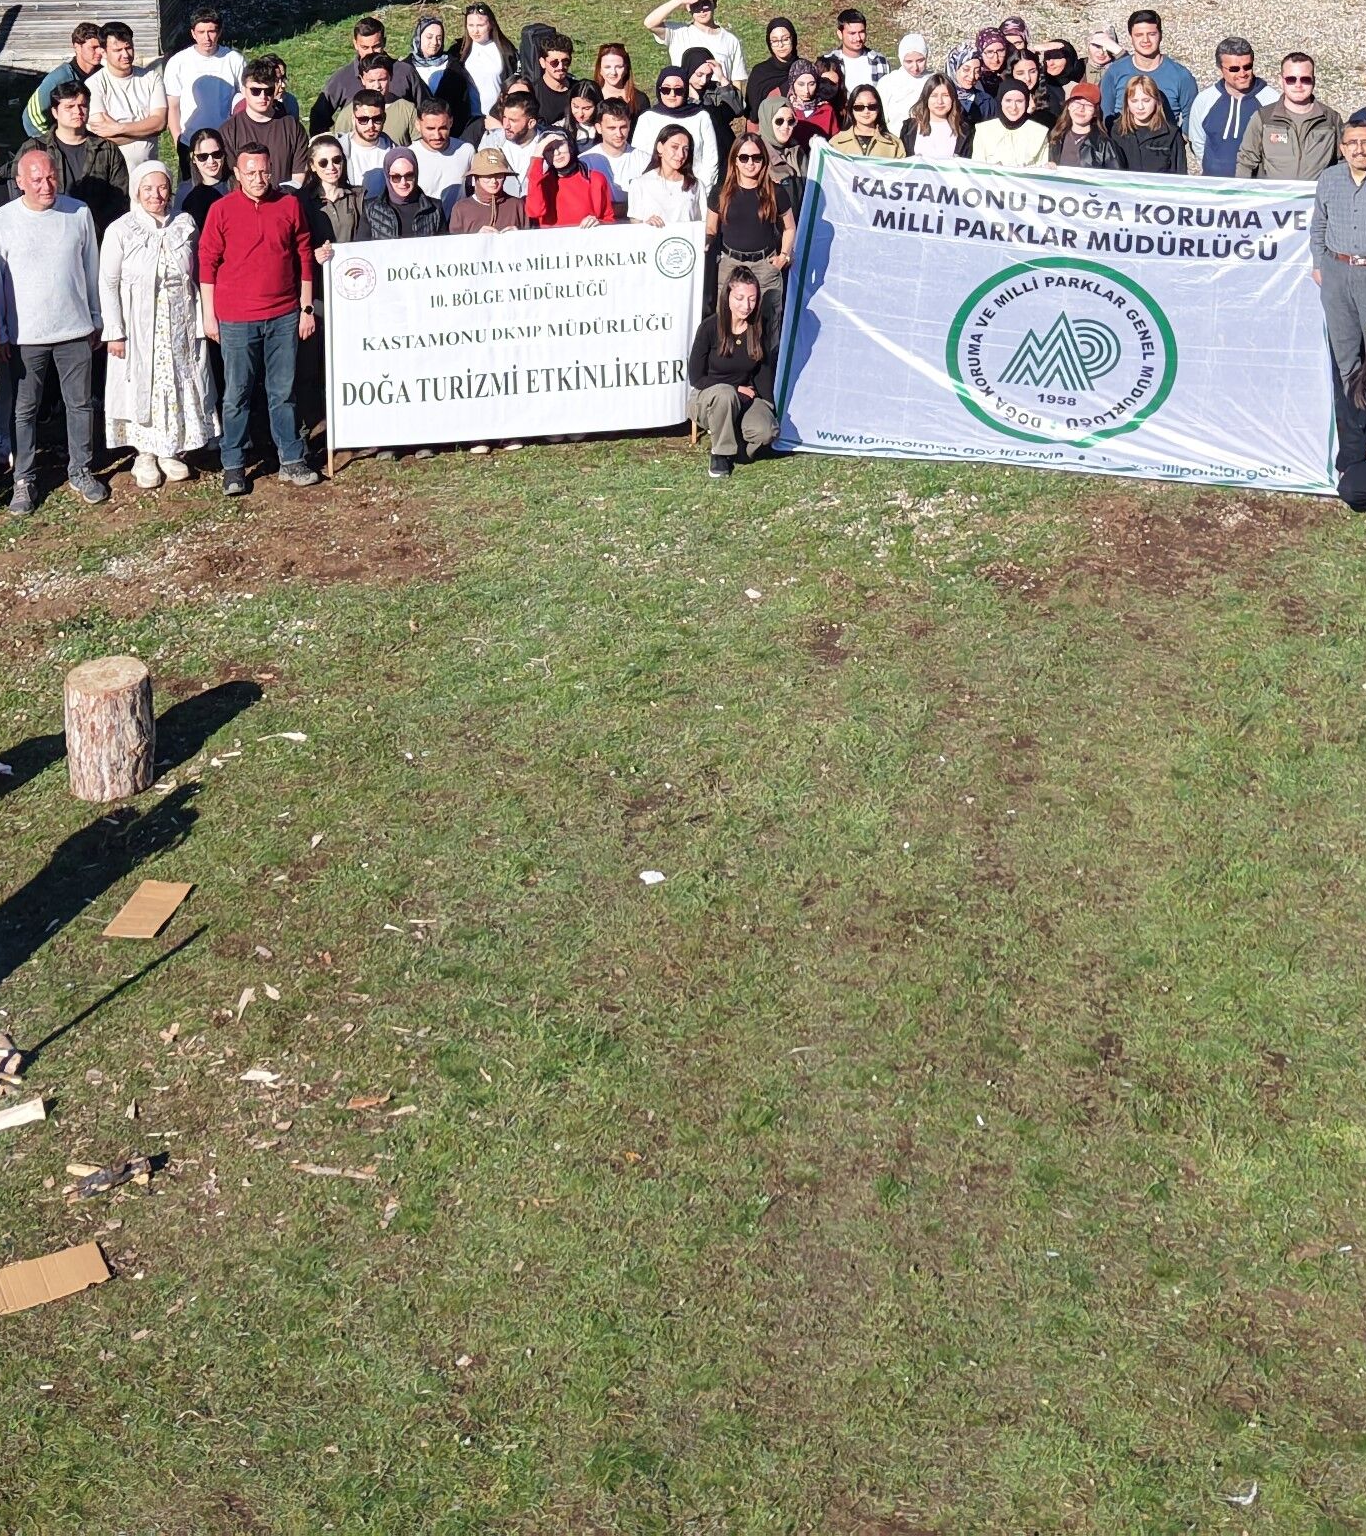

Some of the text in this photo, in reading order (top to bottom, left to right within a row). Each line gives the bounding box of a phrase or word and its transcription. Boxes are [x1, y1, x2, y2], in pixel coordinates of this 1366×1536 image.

[852, 175, 1307, 231] KASTAMONU DOĞA KORUMA VE
[872, 207, 1278, 261] MİLLİ PARKLAR MÜDÜRLÜĞÜ
[387, 262, 433, 282] DOĞA
[436, 260, 504, 278] KORUMA
[508, 262, 522, 272] ve
[526, 253, 570, 272] MİLLİ
[575, 251, 647, 268] PARKLAR
[430, 279, 608, 308] 10. BÖLGE MÜDÜRLÜĞÜ
[362, 313, 673, 351] KASTAMONU DKMP MÜDÜRLÜĞÜ
[967, 276, 1155, 431] DOĞA KORUMA VE MİLLİ PARKLAR GENEL MÜDÜRLÜĞÜ
[341, 357, 688, 406] DOĞA TURİZMİ ETKİNLİKLER
[1037, 393, 1077, 406] 1958
